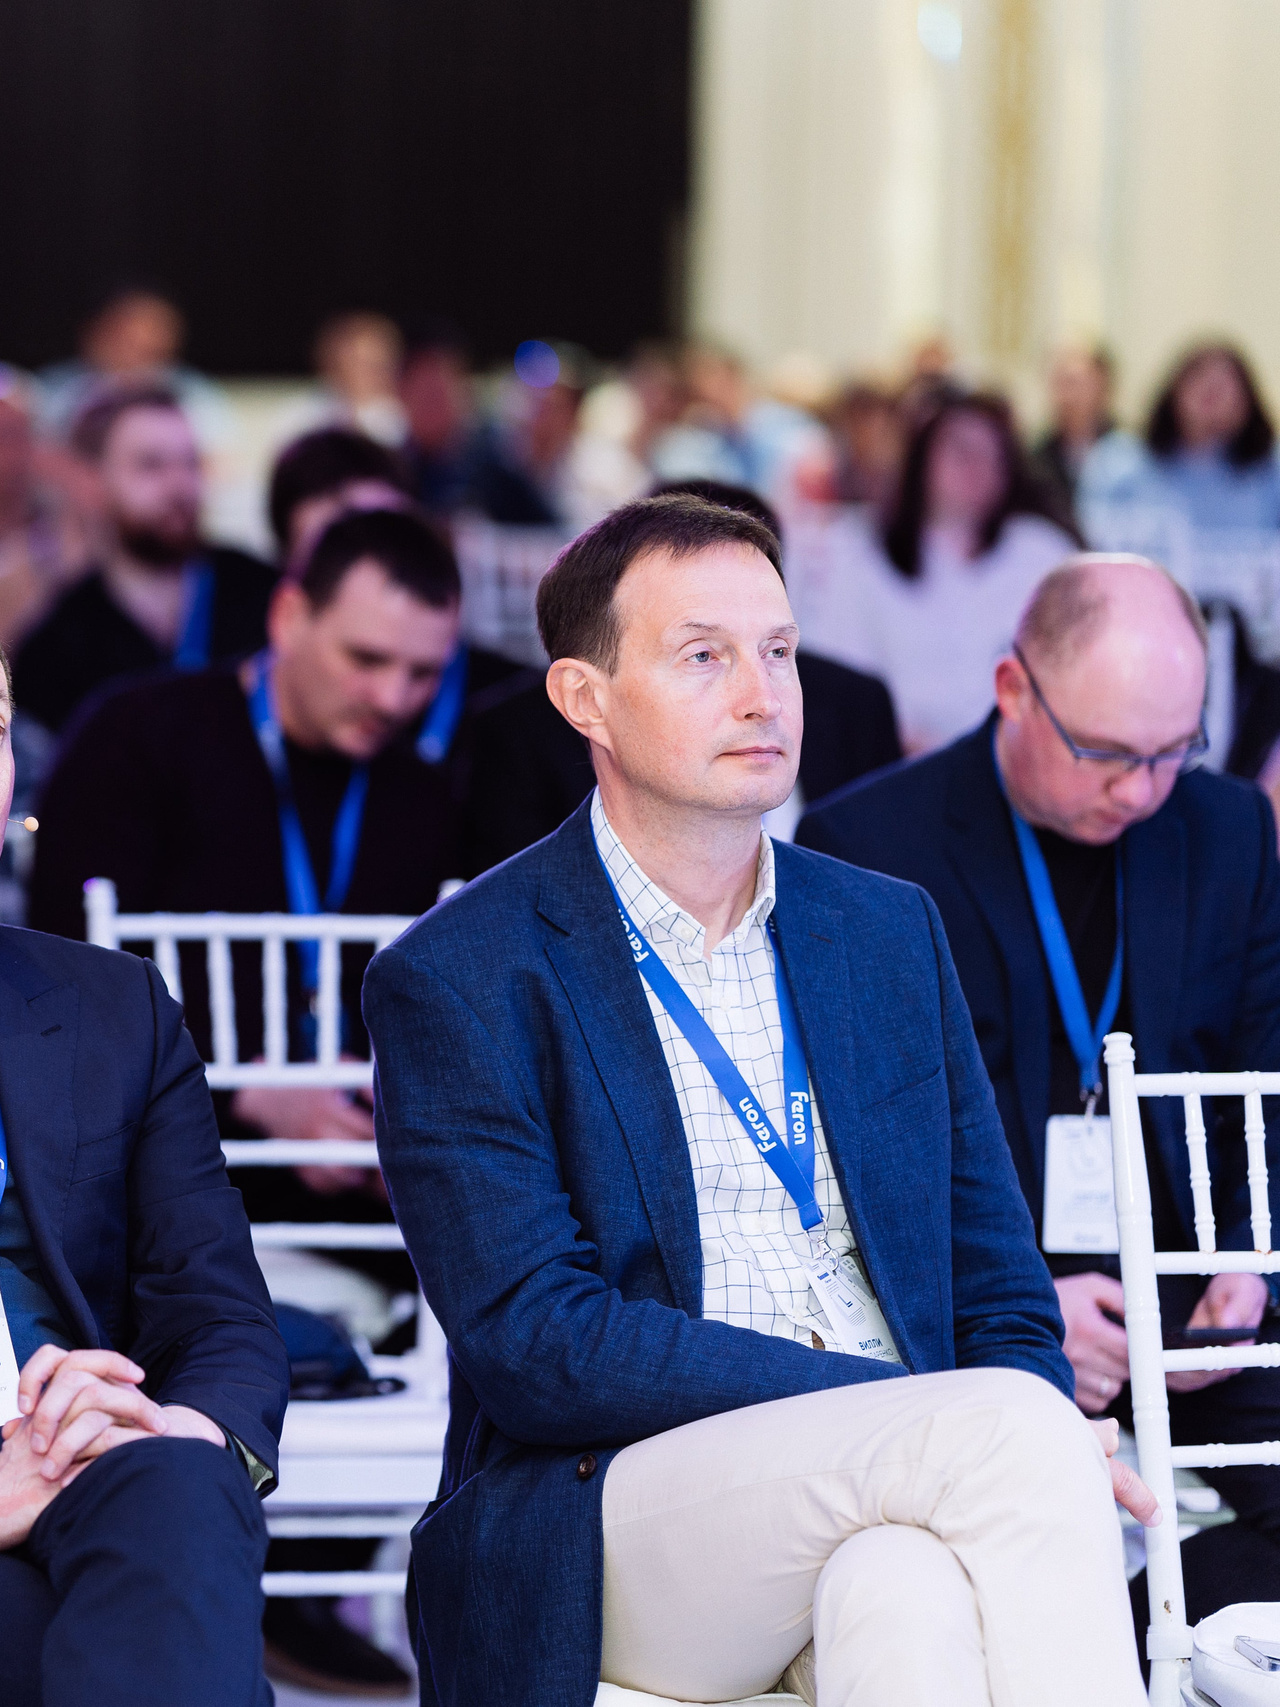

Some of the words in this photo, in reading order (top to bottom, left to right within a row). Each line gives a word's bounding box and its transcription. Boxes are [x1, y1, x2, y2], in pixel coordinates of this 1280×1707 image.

[618, 908, 650, 963] Fer
[738, 1096, 777, 1153] Feron
[790, 1091, 809, 1145] Feron
[858, 1338, 883, 1351] ВИЛЛИ
